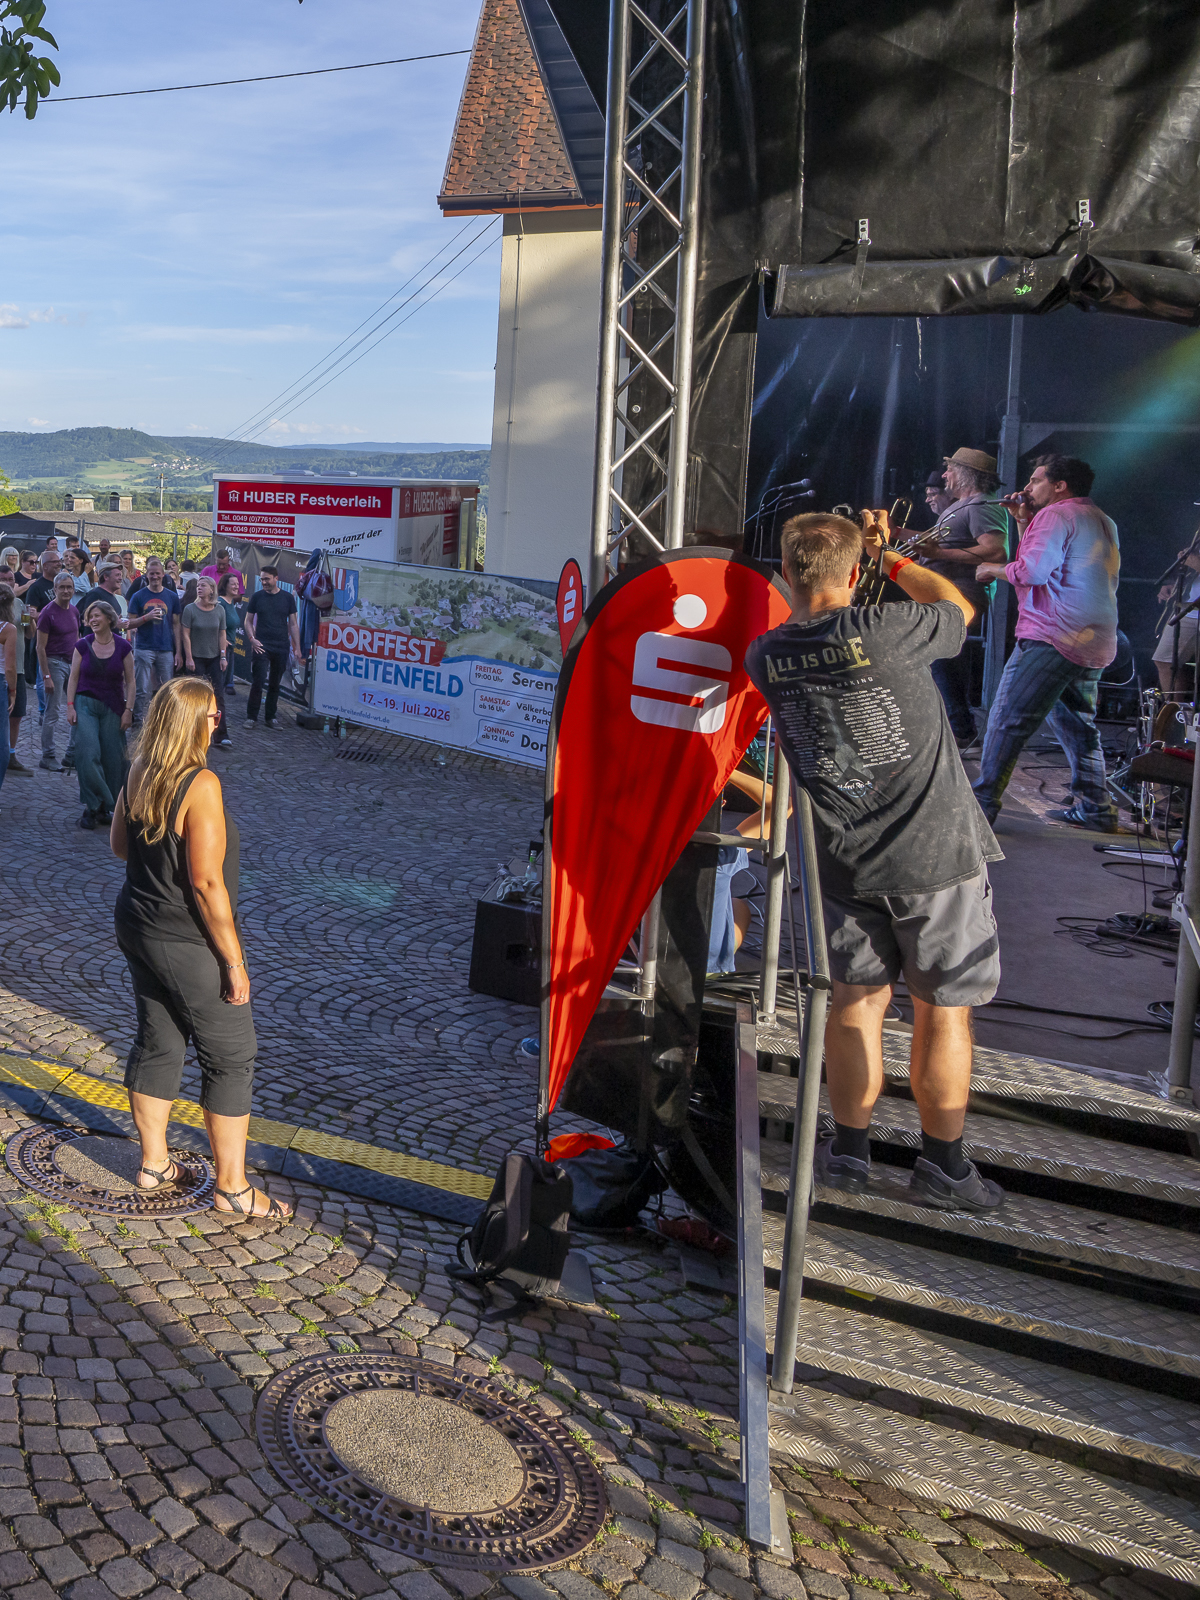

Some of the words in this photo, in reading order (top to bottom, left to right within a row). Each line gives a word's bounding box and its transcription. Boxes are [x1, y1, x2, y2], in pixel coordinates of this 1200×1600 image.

[244, 491, 296, 504] HUBER
[300, 493, 381, 508] Festverleih
[343, 532, 364, 543] tanzt
[366, 528, 383, 539] der
[328, 624, 435, 664] DORFFEST
[800, 653, 820, 669] IS
[326, 650, 463, 698] BREITENFELD
[475, 665, 502, 675] FREITAG
[480, 695, 510, 706] SAMSTAG
[322, 703, 390, 724] www.breitenfeld-wt.de
[402, 702, 421, 715] Juli
[424, 706, 450, 721] 2026
[483, 725, 515, 737] SONNTAG
